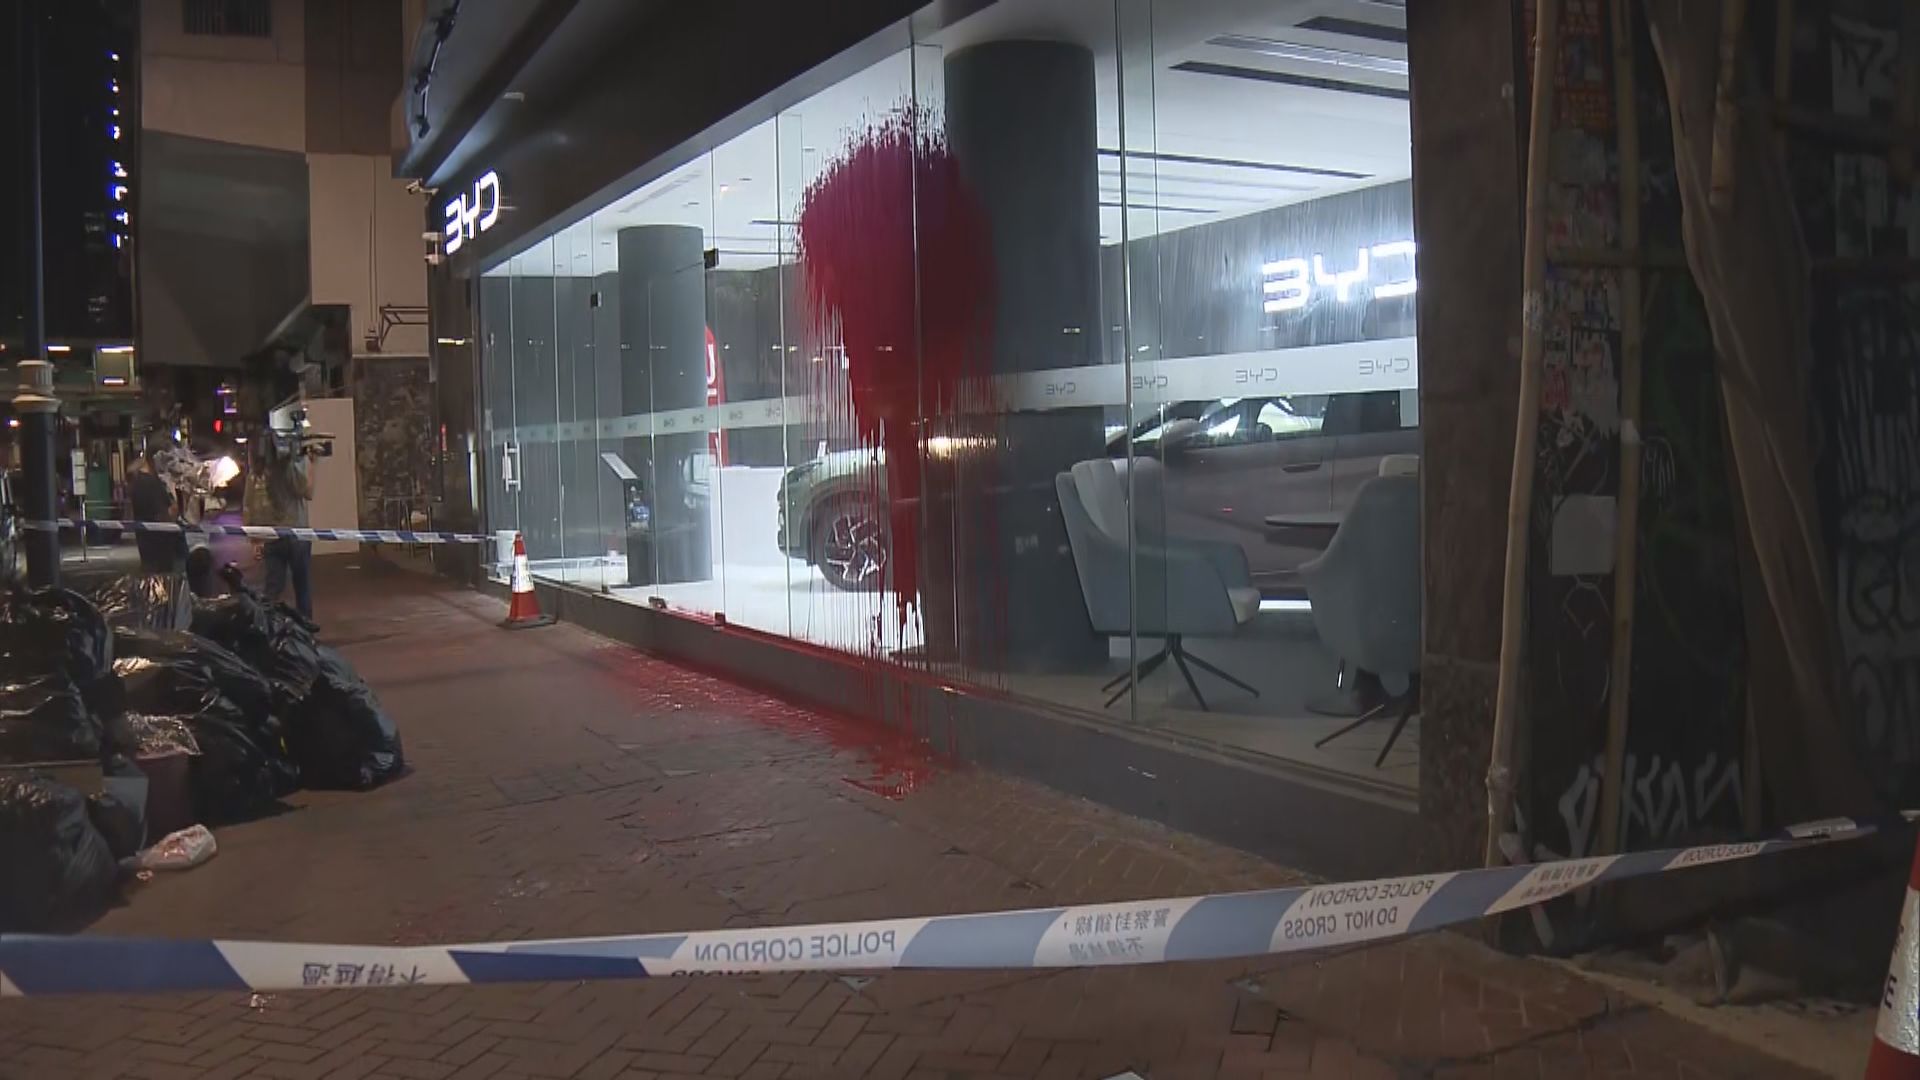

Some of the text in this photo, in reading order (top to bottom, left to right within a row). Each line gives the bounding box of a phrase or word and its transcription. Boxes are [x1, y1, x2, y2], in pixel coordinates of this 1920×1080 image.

[445, 170, 500, 255] BYD
[1262, 239, 1417, 313] BYD
[1359, 358, 1410, 375] BYD
[1132, 375, 1168, 389] BYD
[1235, 368, 1278, 383] BYD
[1046, 382, 1076, 395] BYD
